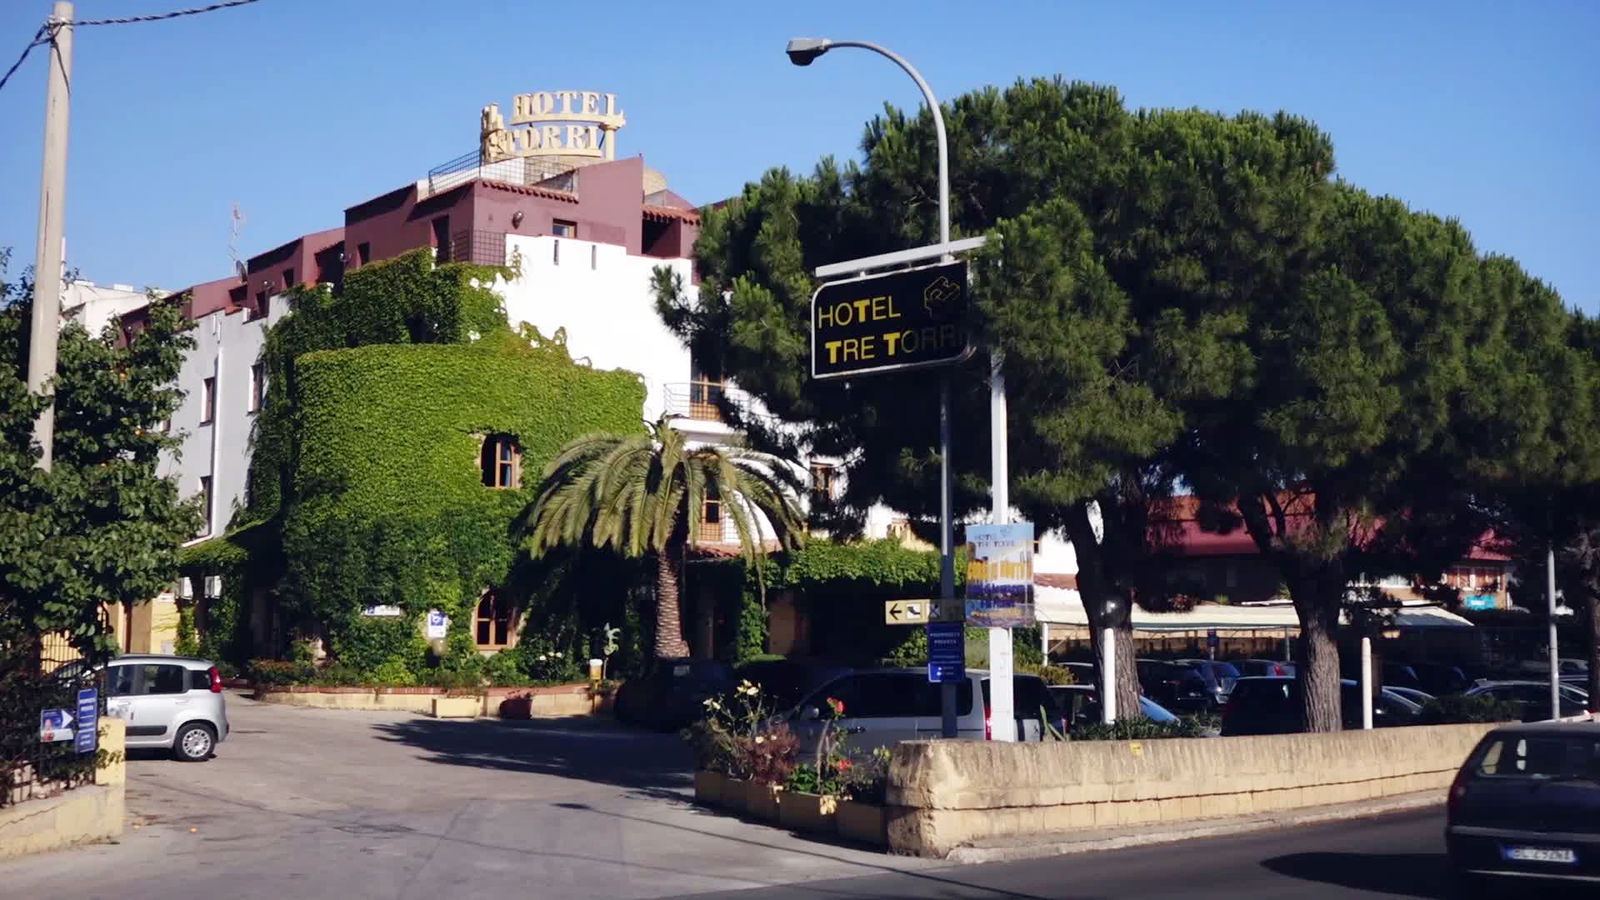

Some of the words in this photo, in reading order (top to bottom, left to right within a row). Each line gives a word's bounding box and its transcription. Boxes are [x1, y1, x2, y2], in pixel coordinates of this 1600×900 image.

[513, 90, 624, 118] HOTEL
[817, 295, 901, 329] HOTEL
[825, 335, 875, 364] TRE
[883, 322, 967, 357] TORR
